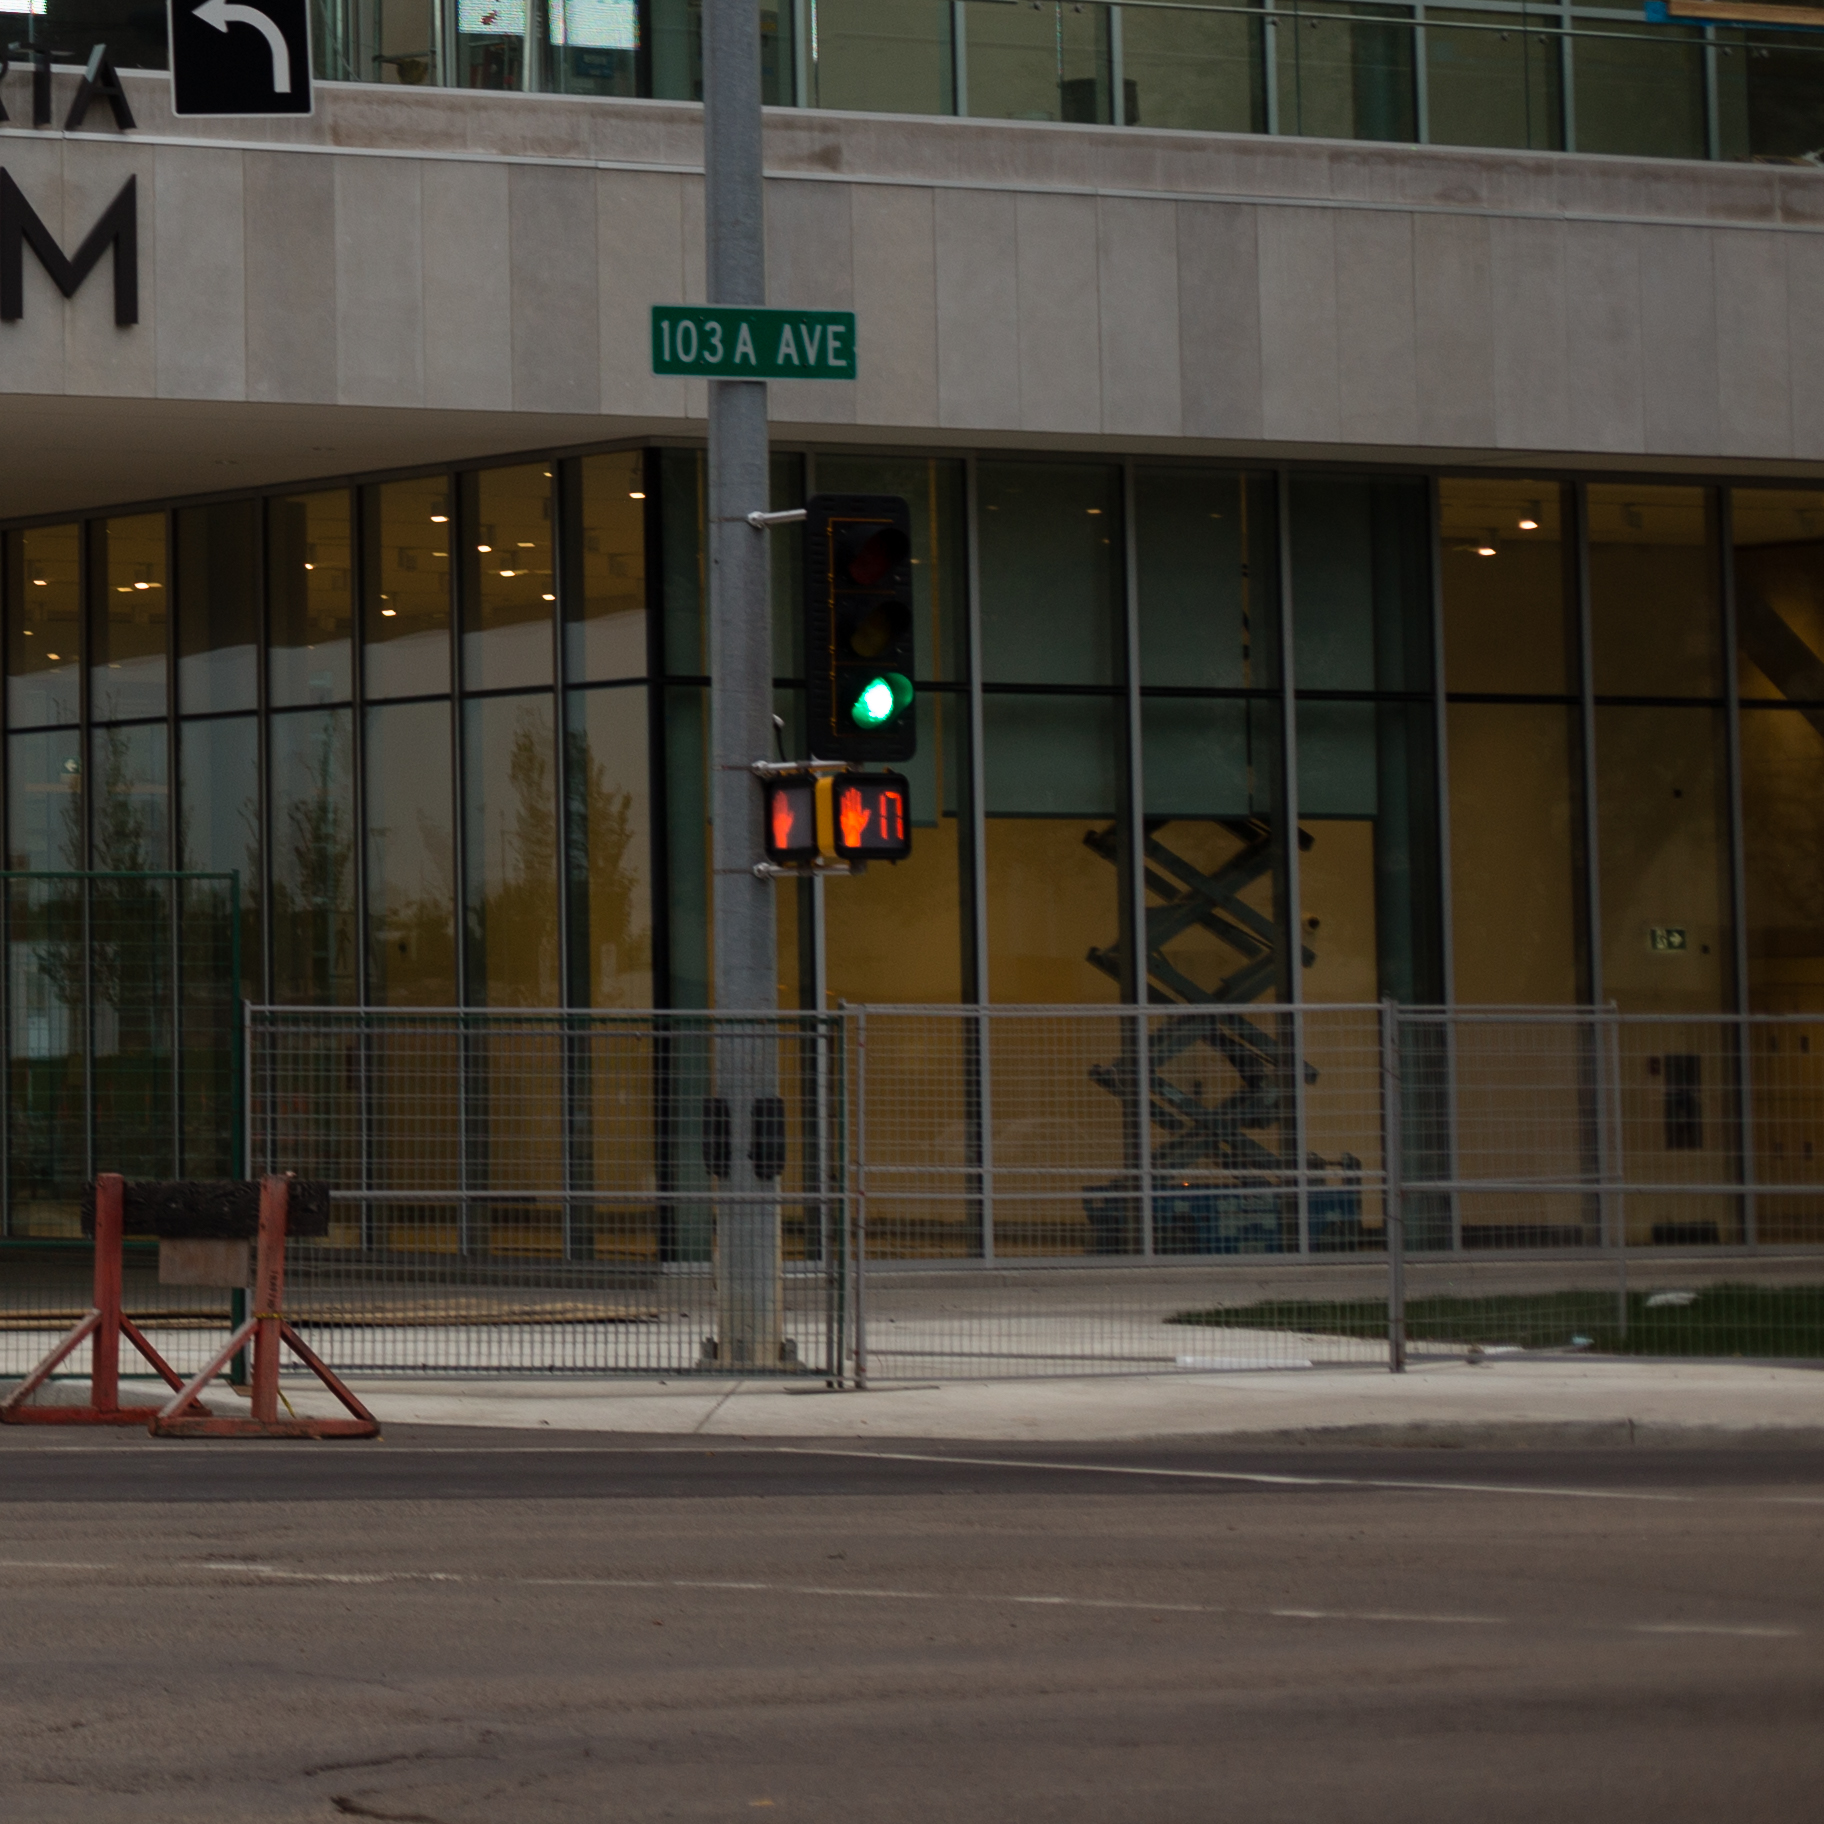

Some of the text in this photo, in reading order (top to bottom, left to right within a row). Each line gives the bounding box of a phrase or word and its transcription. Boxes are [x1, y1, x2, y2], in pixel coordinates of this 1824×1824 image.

[660, 319, 848, 367] 103A AVE
[879, 790, 905, 841] 17
